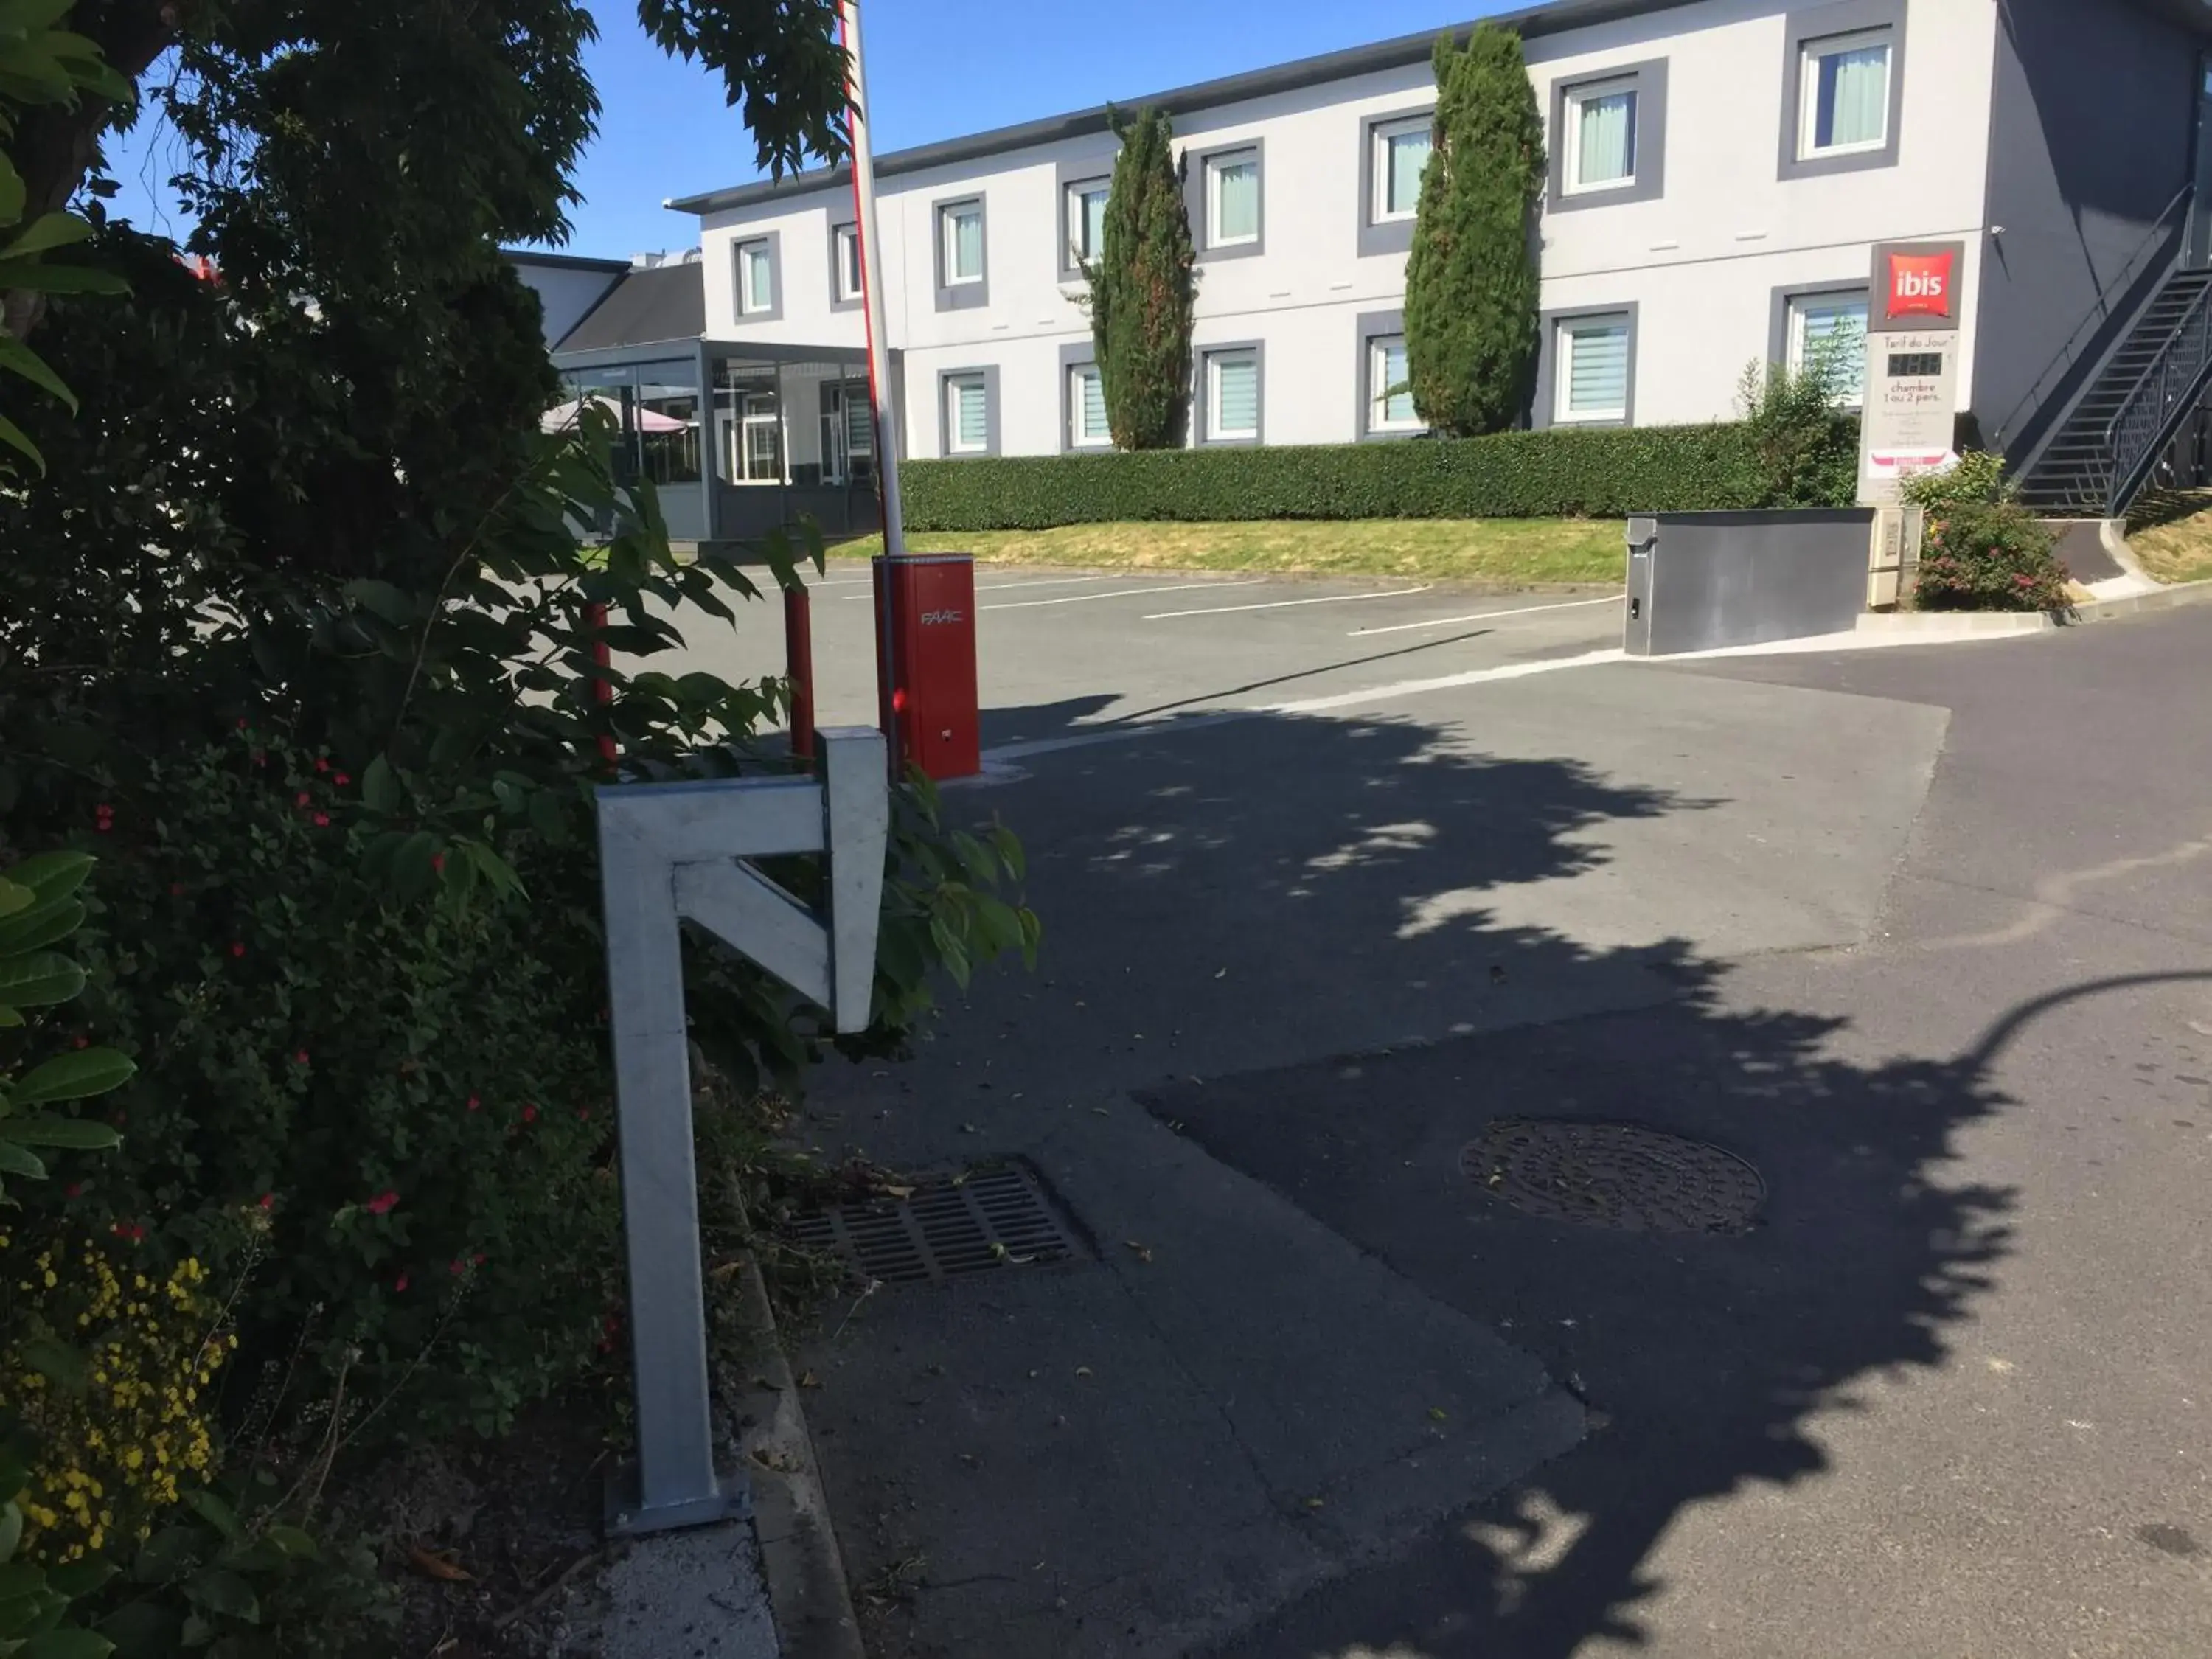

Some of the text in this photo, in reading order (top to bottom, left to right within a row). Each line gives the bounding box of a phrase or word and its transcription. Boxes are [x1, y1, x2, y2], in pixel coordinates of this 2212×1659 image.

[1896, 271, 1942, 297] ibis
[1885, 335, 1908, 349] Tarif
[1891, 380, 1935, 393] chambre
[1906, 393, 1913, 402] 2
[921, 610, 964, 625] FAAC
